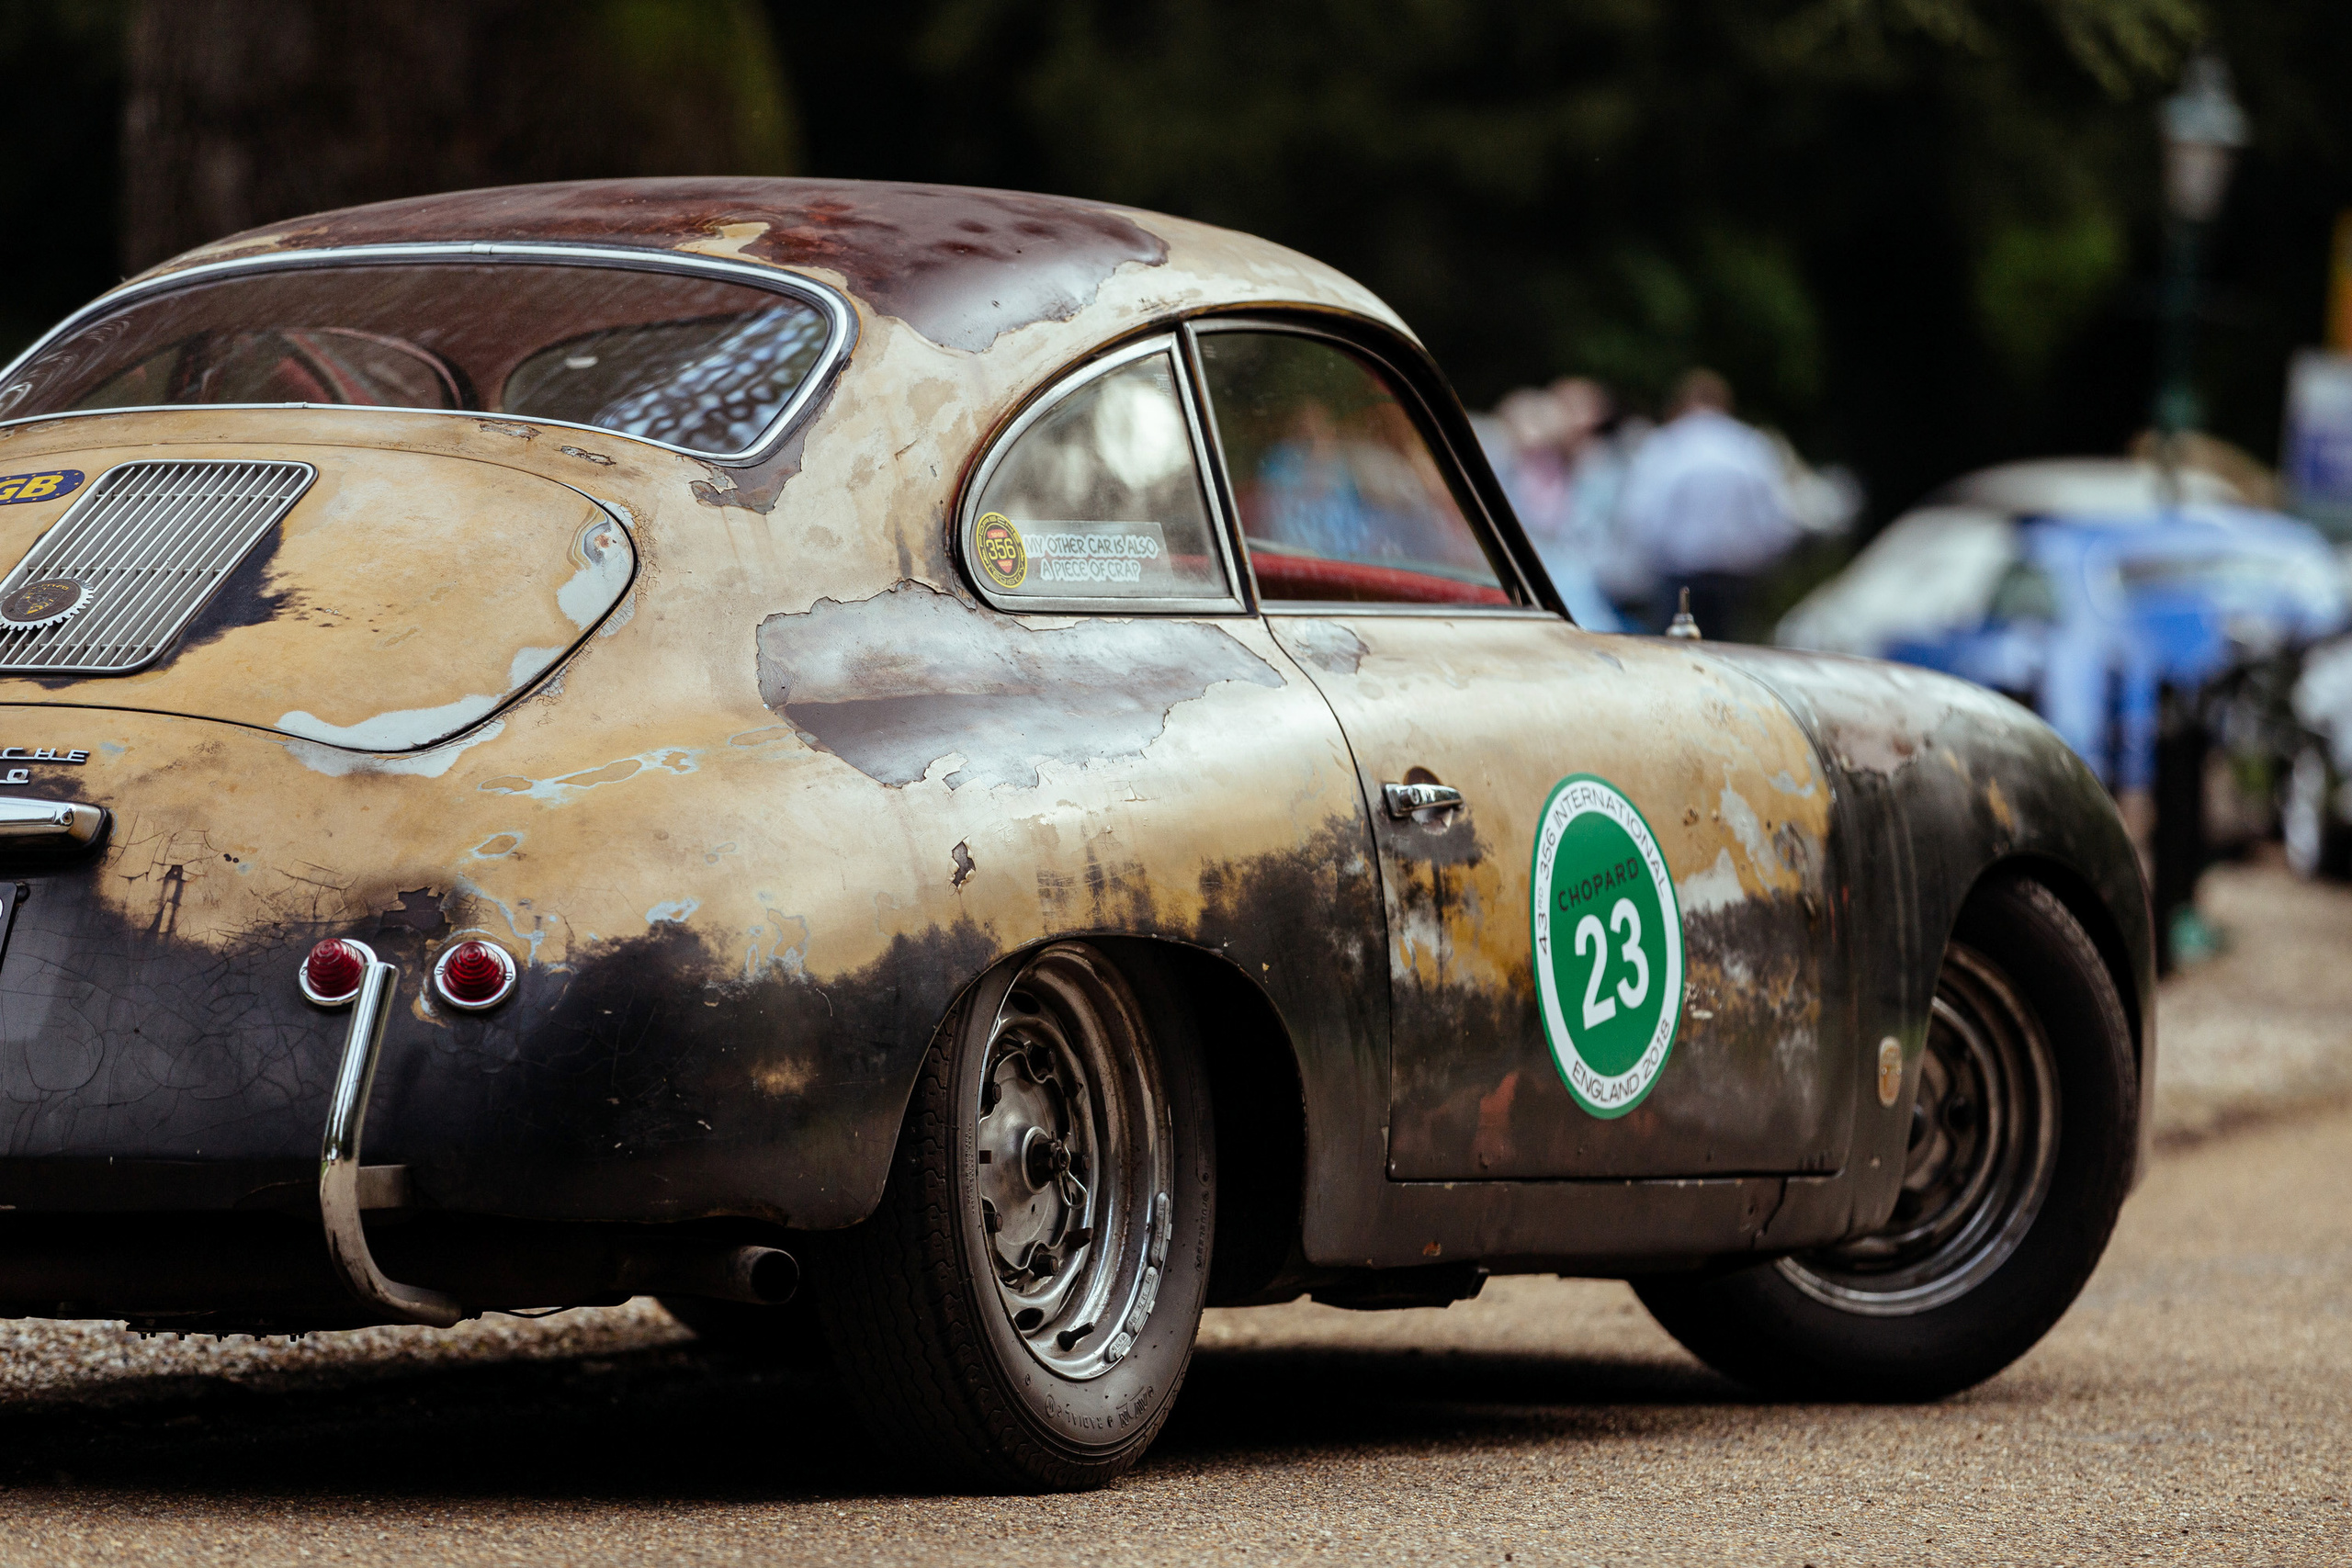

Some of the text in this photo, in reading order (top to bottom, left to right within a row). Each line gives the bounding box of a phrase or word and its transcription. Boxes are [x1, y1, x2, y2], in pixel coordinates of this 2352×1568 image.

[985, 537, 1017, 560] 356
[1023, 535, 1044, 555] MY
[1046, 536, 1087, 555] OTHER
[1088, 536, 1113, 554] CAR
[1114, 536, 1125, 554] IS
[1127, 538, 1157, 556] ALSO
[1042, 559, 1140, 579] A PIECE OF CRAP
[1539, 827, 1556, 881] 356
[1553, 786, 1667, 899] INTERNATIONAL
[1558, 856, 1639, 912] CHOPARD
[1574, 897, 1650, 1031] 23
[1572, 1018, 1671, 1103] ENGLAND 2018
